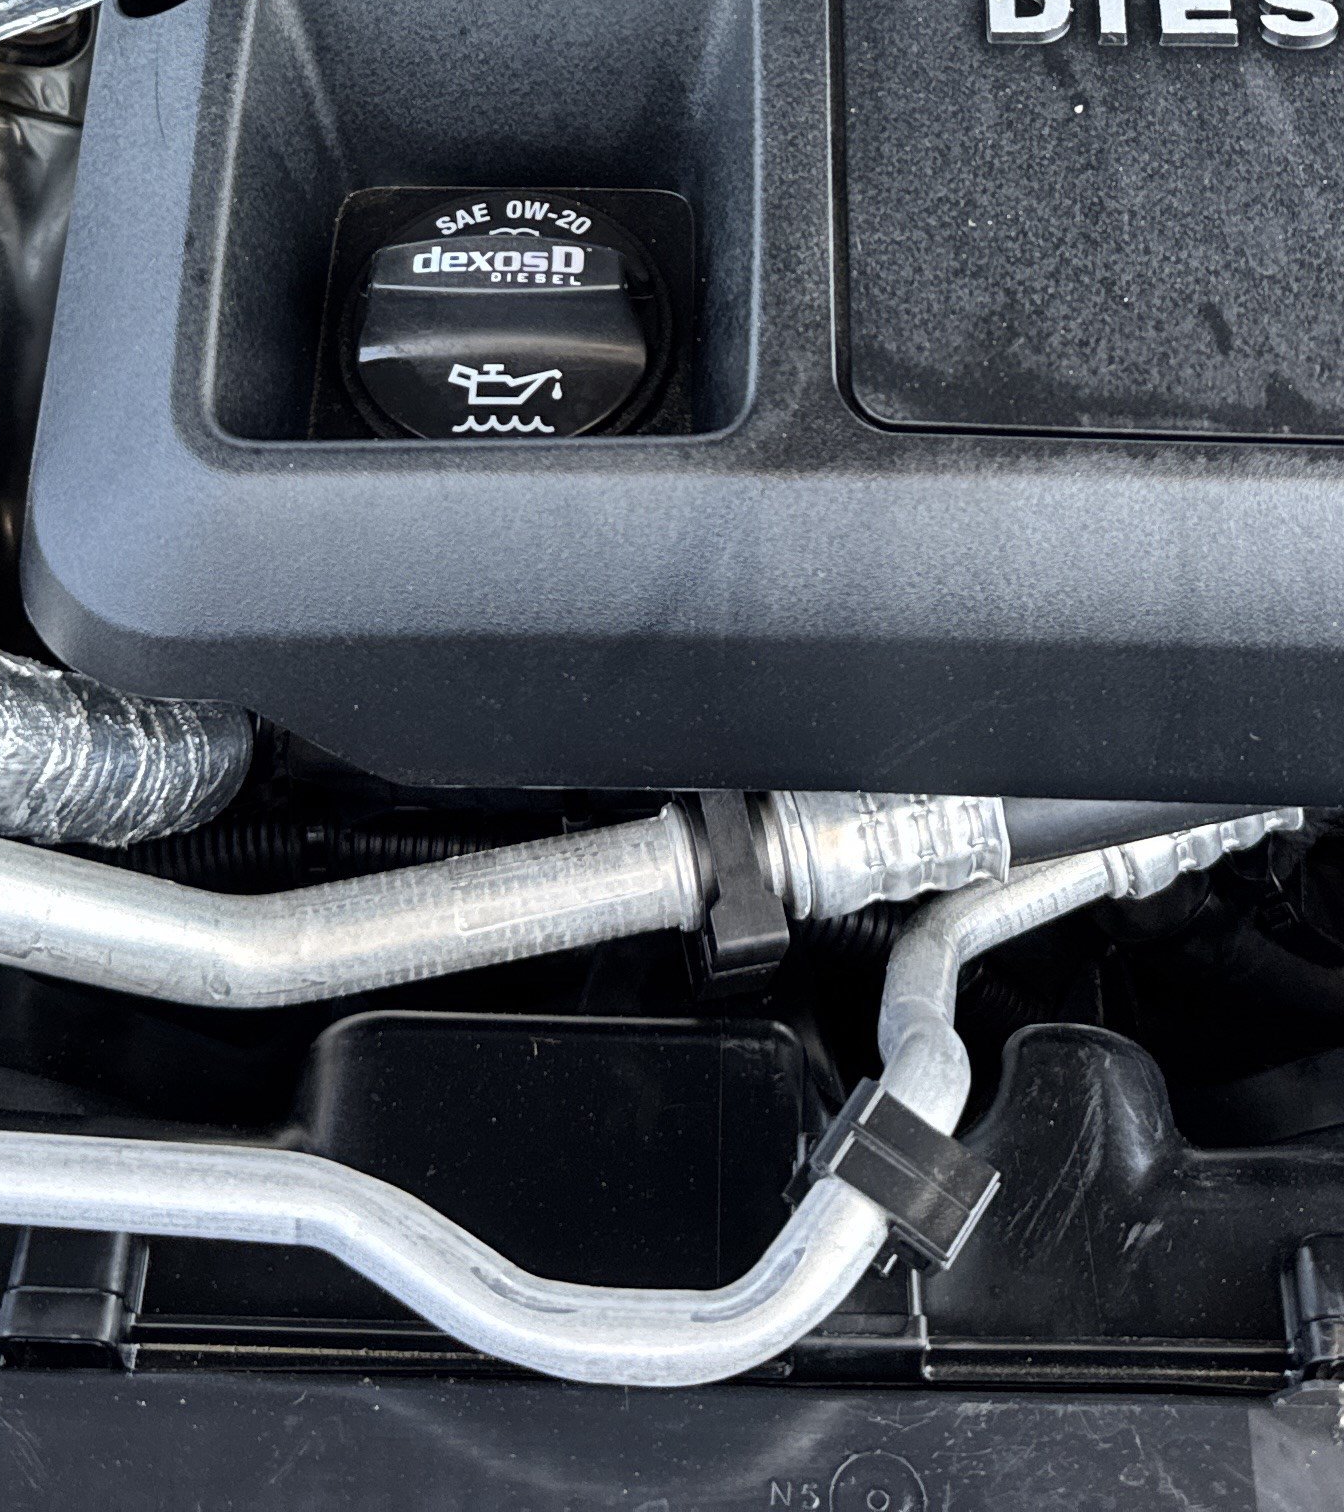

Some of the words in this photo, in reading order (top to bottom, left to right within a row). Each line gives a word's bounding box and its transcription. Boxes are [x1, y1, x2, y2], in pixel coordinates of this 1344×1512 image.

[435, 202, 491, 236] SAE
[505, 199, 592, 235] 0W-20
[490, 272, 582, 286] DIESEL
